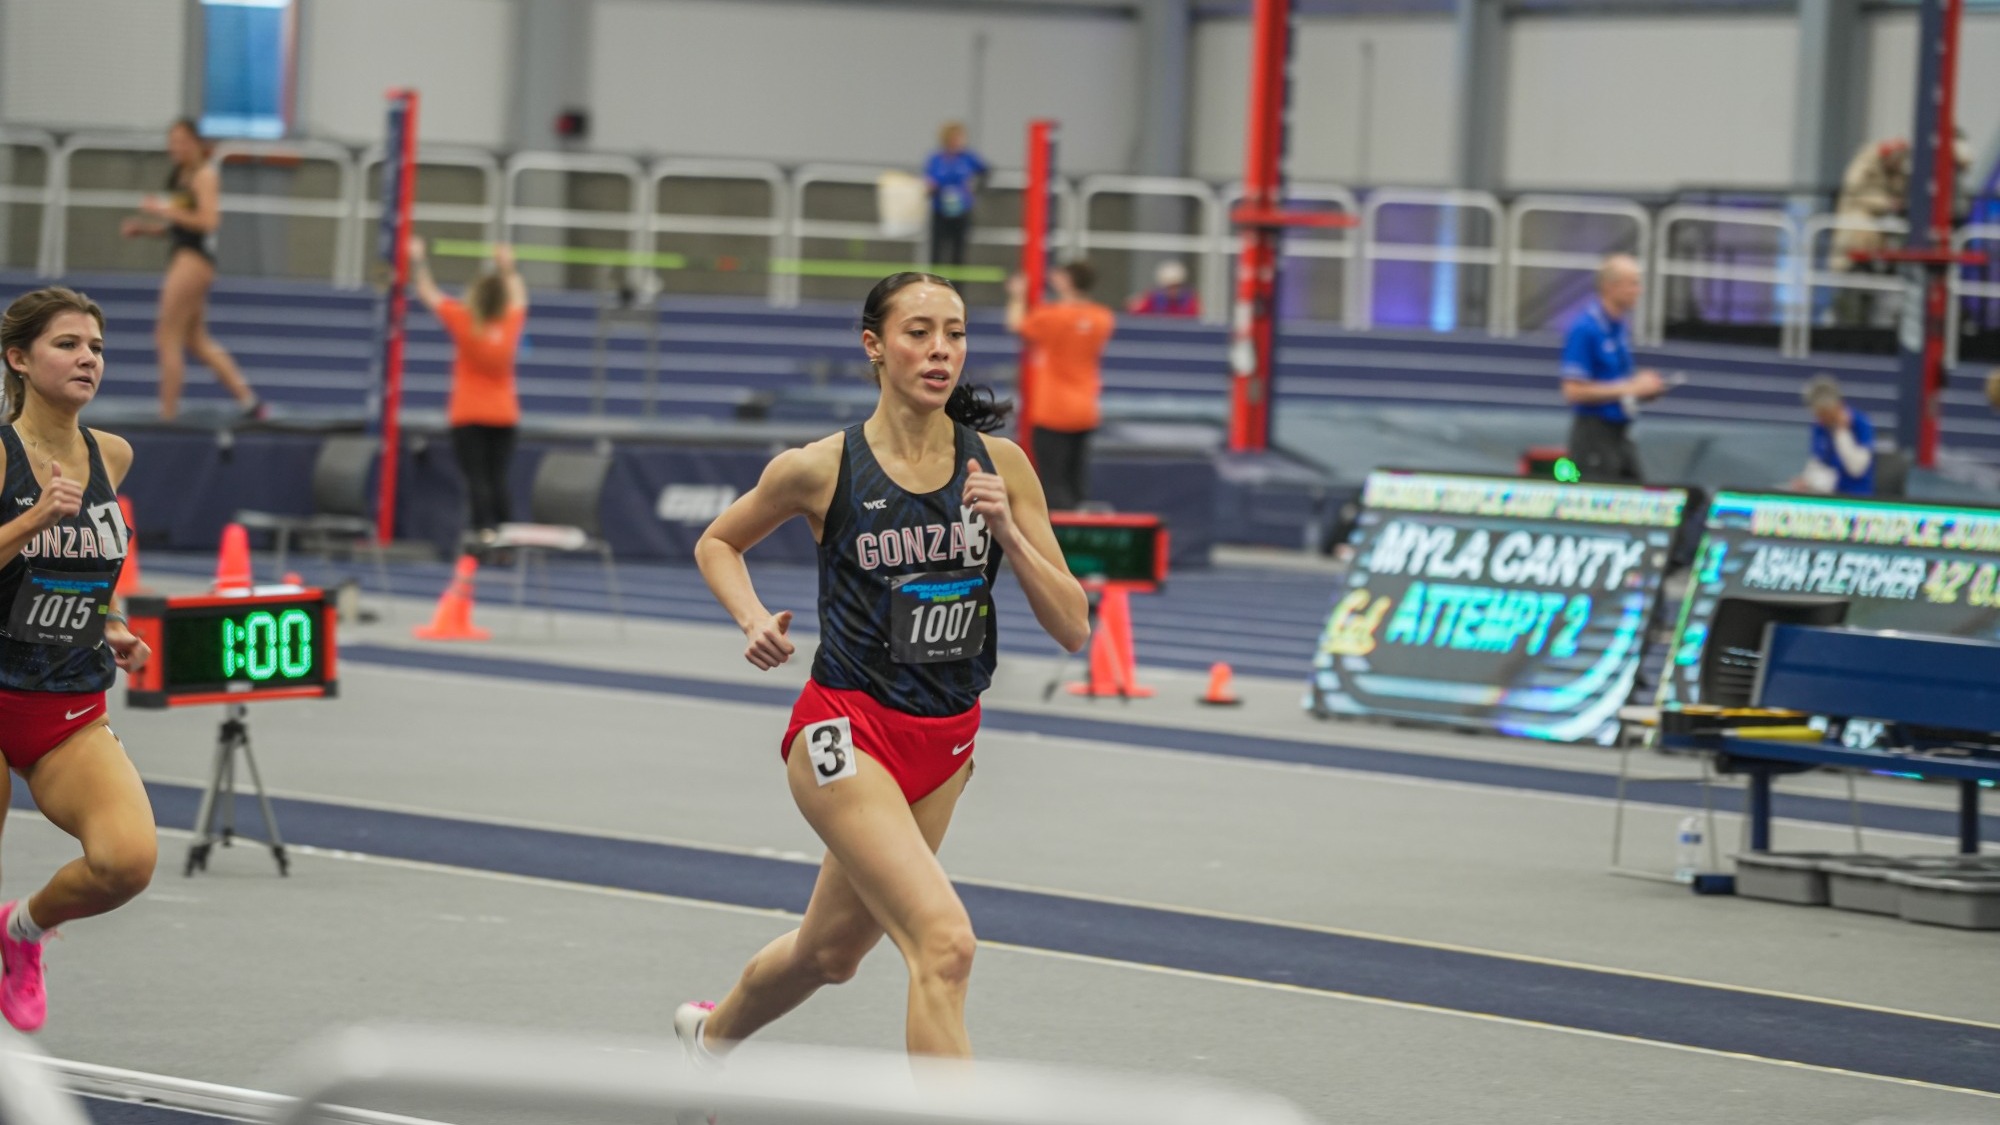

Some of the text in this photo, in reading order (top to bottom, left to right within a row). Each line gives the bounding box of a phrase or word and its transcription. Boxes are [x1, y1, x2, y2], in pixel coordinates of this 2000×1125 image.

[969, 509, 989, 562] 3
[1369, 520, 1646, 591] MYLA CANTY
[1803, 549, 1927, 600] FLETCHER
[26, 593, 95, 630] 1015
[910, 600, 977, 643] 1007
[1385, 581, 1592, 658] ATTEMPT 2
[223, 609, 312, 680] 1:00
[812, 725, 847, 777] 3
